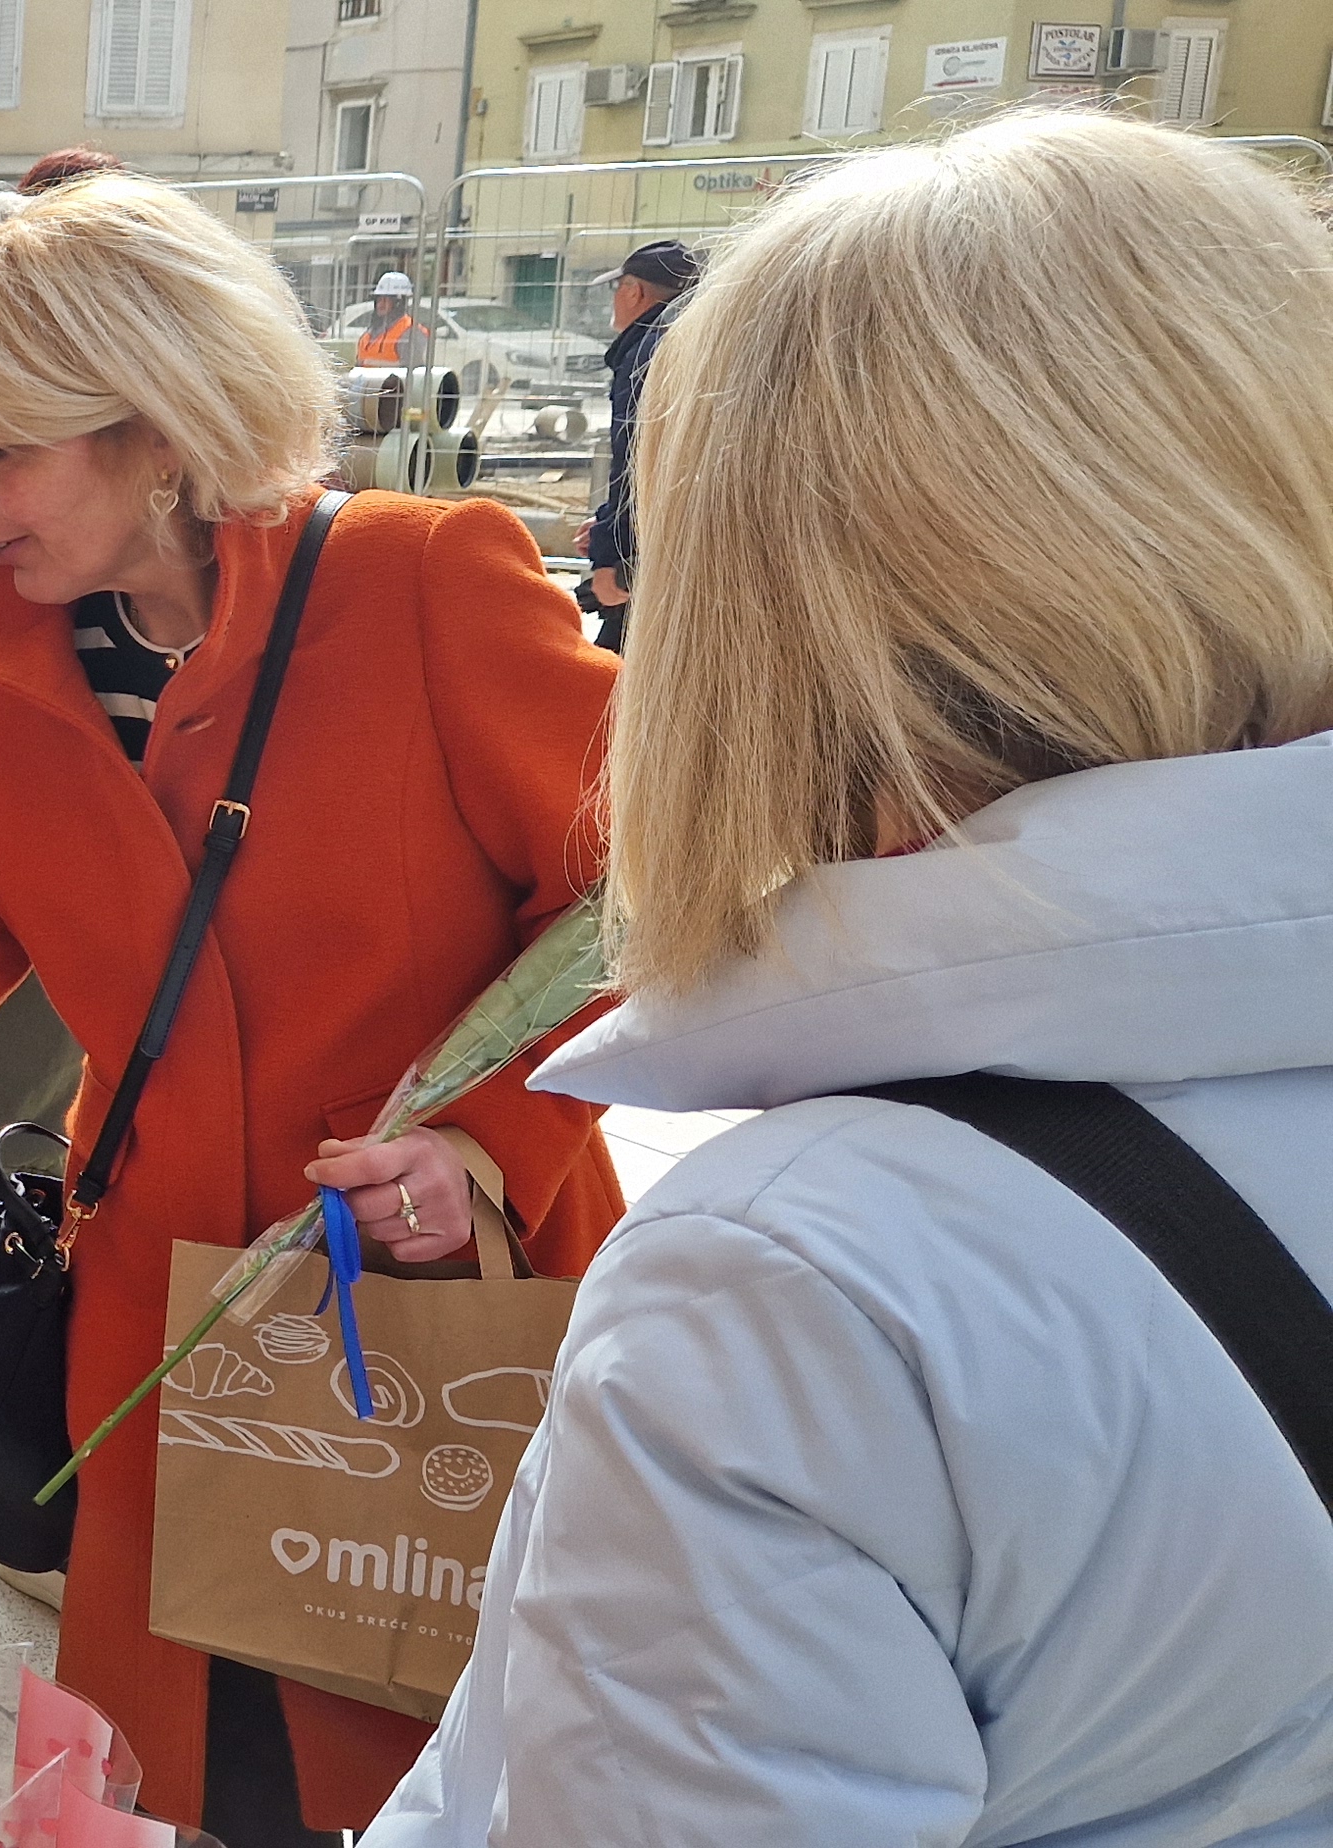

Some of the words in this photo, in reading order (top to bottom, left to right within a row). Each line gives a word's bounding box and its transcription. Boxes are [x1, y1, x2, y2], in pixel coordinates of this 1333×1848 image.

[693, 173, 753, 191] Optika
[304, 1603, 346, 1620] OKUS
[418, 1624, 438, 1637] OD
